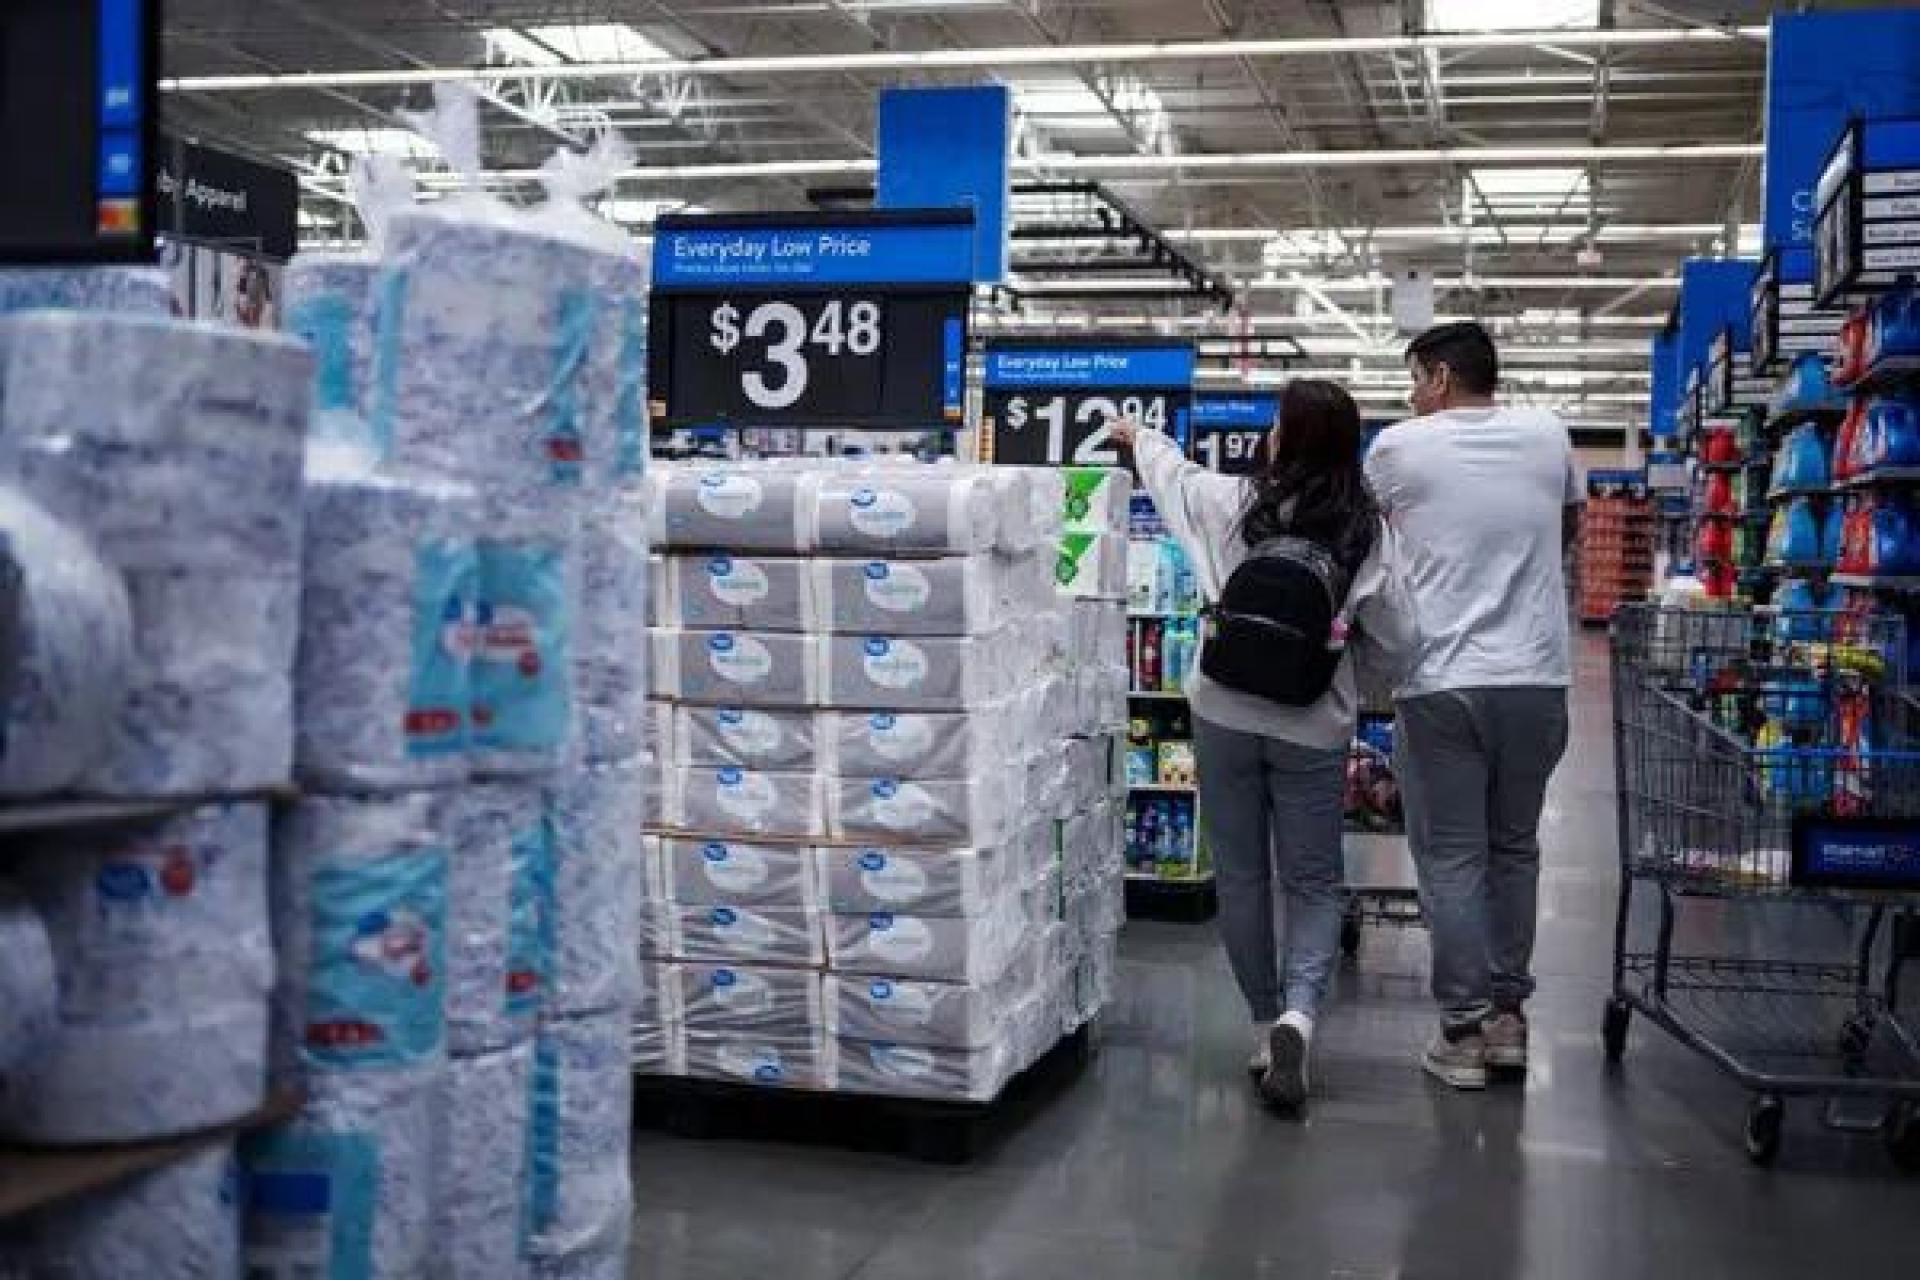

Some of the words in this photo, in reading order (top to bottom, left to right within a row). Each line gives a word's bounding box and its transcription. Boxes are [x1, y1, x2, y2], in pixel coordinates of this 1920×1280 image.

[185, 178, 247, 211] Apparel
[674, 236, 767, 263] Everyday
[770, 236, 814, 256] Low
[818, 236, 872, 256] Price
[997, 354, 1060, 373] Everyday
[1063, 354, 1093, 369] Low
[1094, 354, 1128, 369] Price
